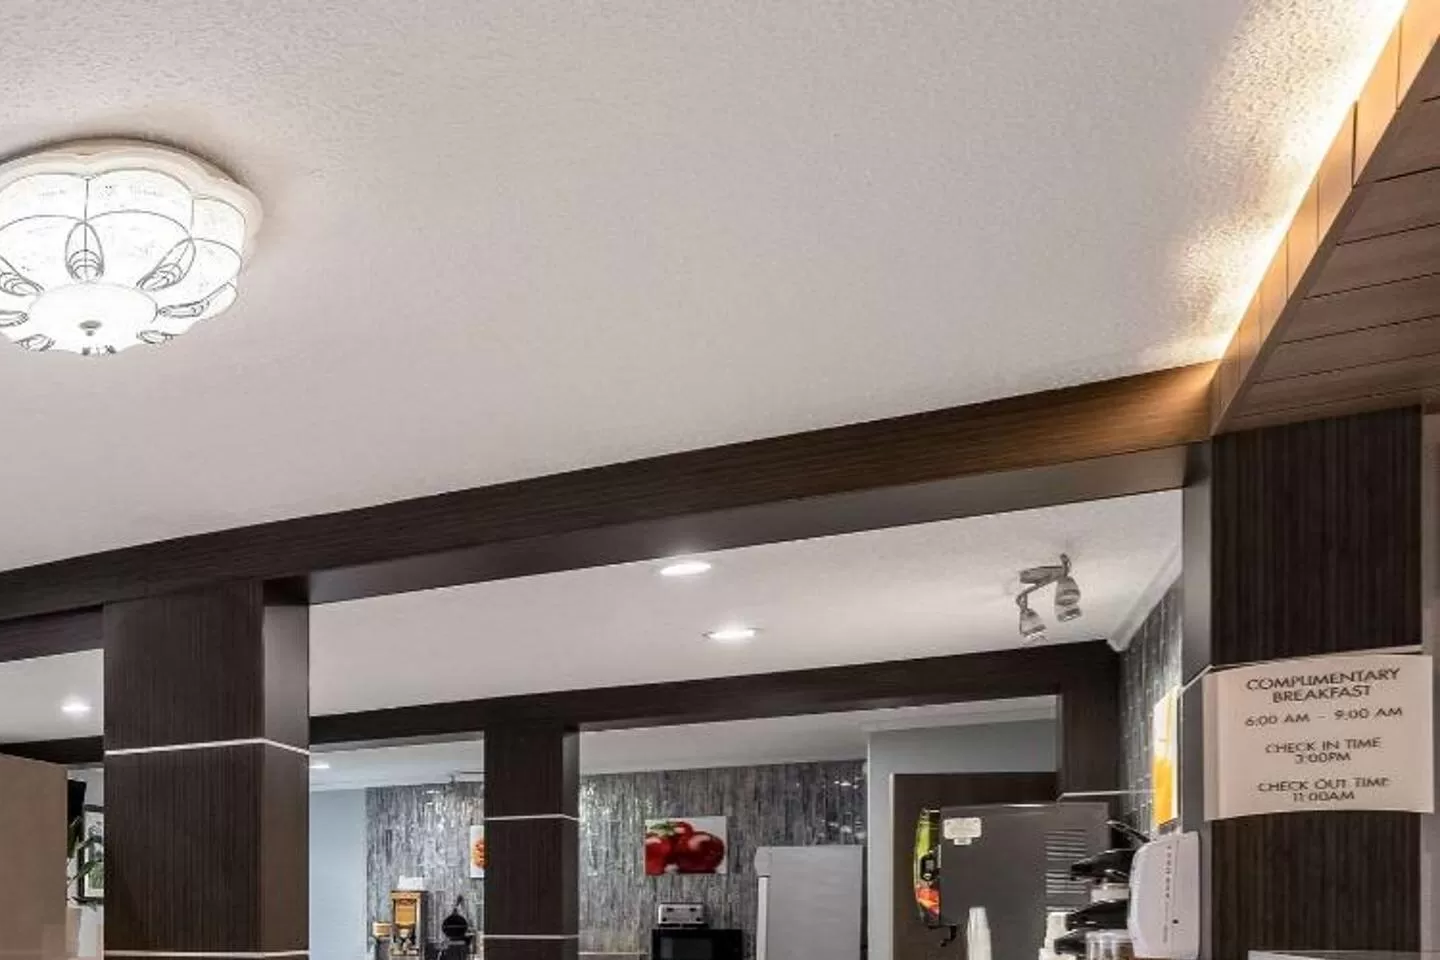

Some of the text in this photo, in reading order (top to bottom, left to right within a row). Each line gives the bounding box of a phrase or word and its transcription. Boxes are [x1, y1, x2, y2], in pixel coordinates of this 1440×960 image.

[1246, 668, 1400, 691] COMPLIMENTARY
[1272, 685, 1371, 703] BREAKFAST
[1245, 715, 1278, 727] 6:00
[1283, 714, 1310, 723] AM
[1333, 708, 1370, 721] 9:00
[1375, 707, 1403, 717] AM
[1265, 737, 1382, 754] CHECK IN TIME
[1295, 752, 1352, 764] 3:00PM
[1257, 776, 1391, 792] CHECK OUT TIME
